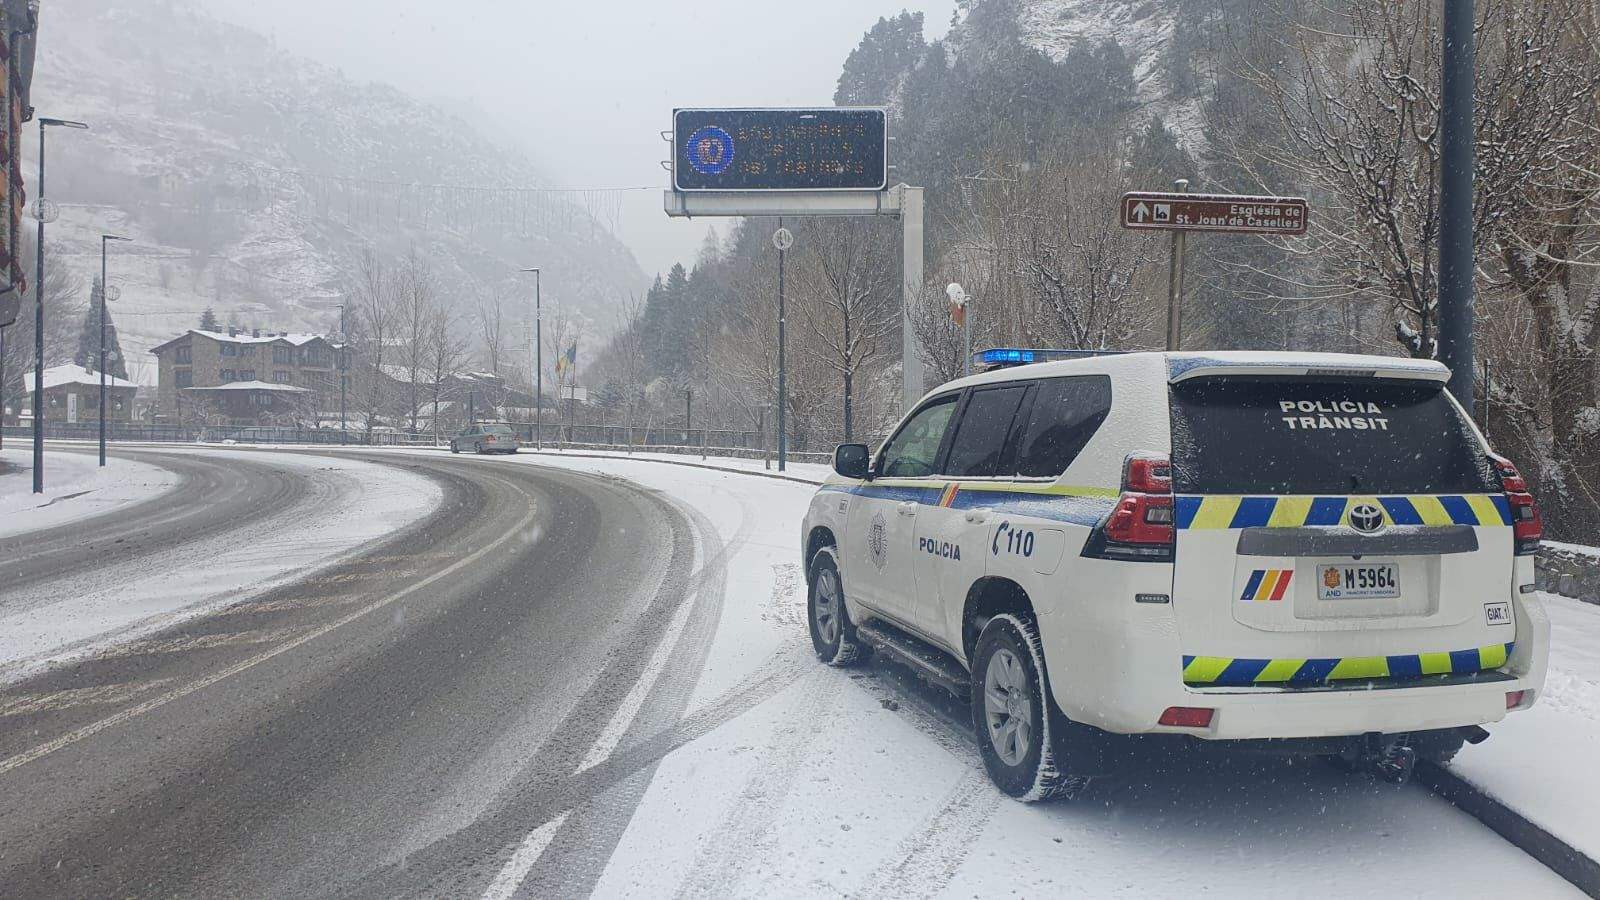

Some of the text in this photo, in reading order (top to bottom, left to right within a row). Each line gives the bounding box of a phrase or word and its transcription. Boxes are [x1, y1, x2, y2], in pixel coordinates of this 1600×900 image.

[1230, 204, 1300, 217] Església de
[1175, 214, 1300, 228] St. Joan de Caselles
[1279, 400, 1382, 414] POLICIA
[1282, 413, 1388, 430] TRÀNSIT
[919, 537, 961, 561] POLICIA
[1007, 528, 1035, 558] 110
[1325, 590, 1342, 598] AND
